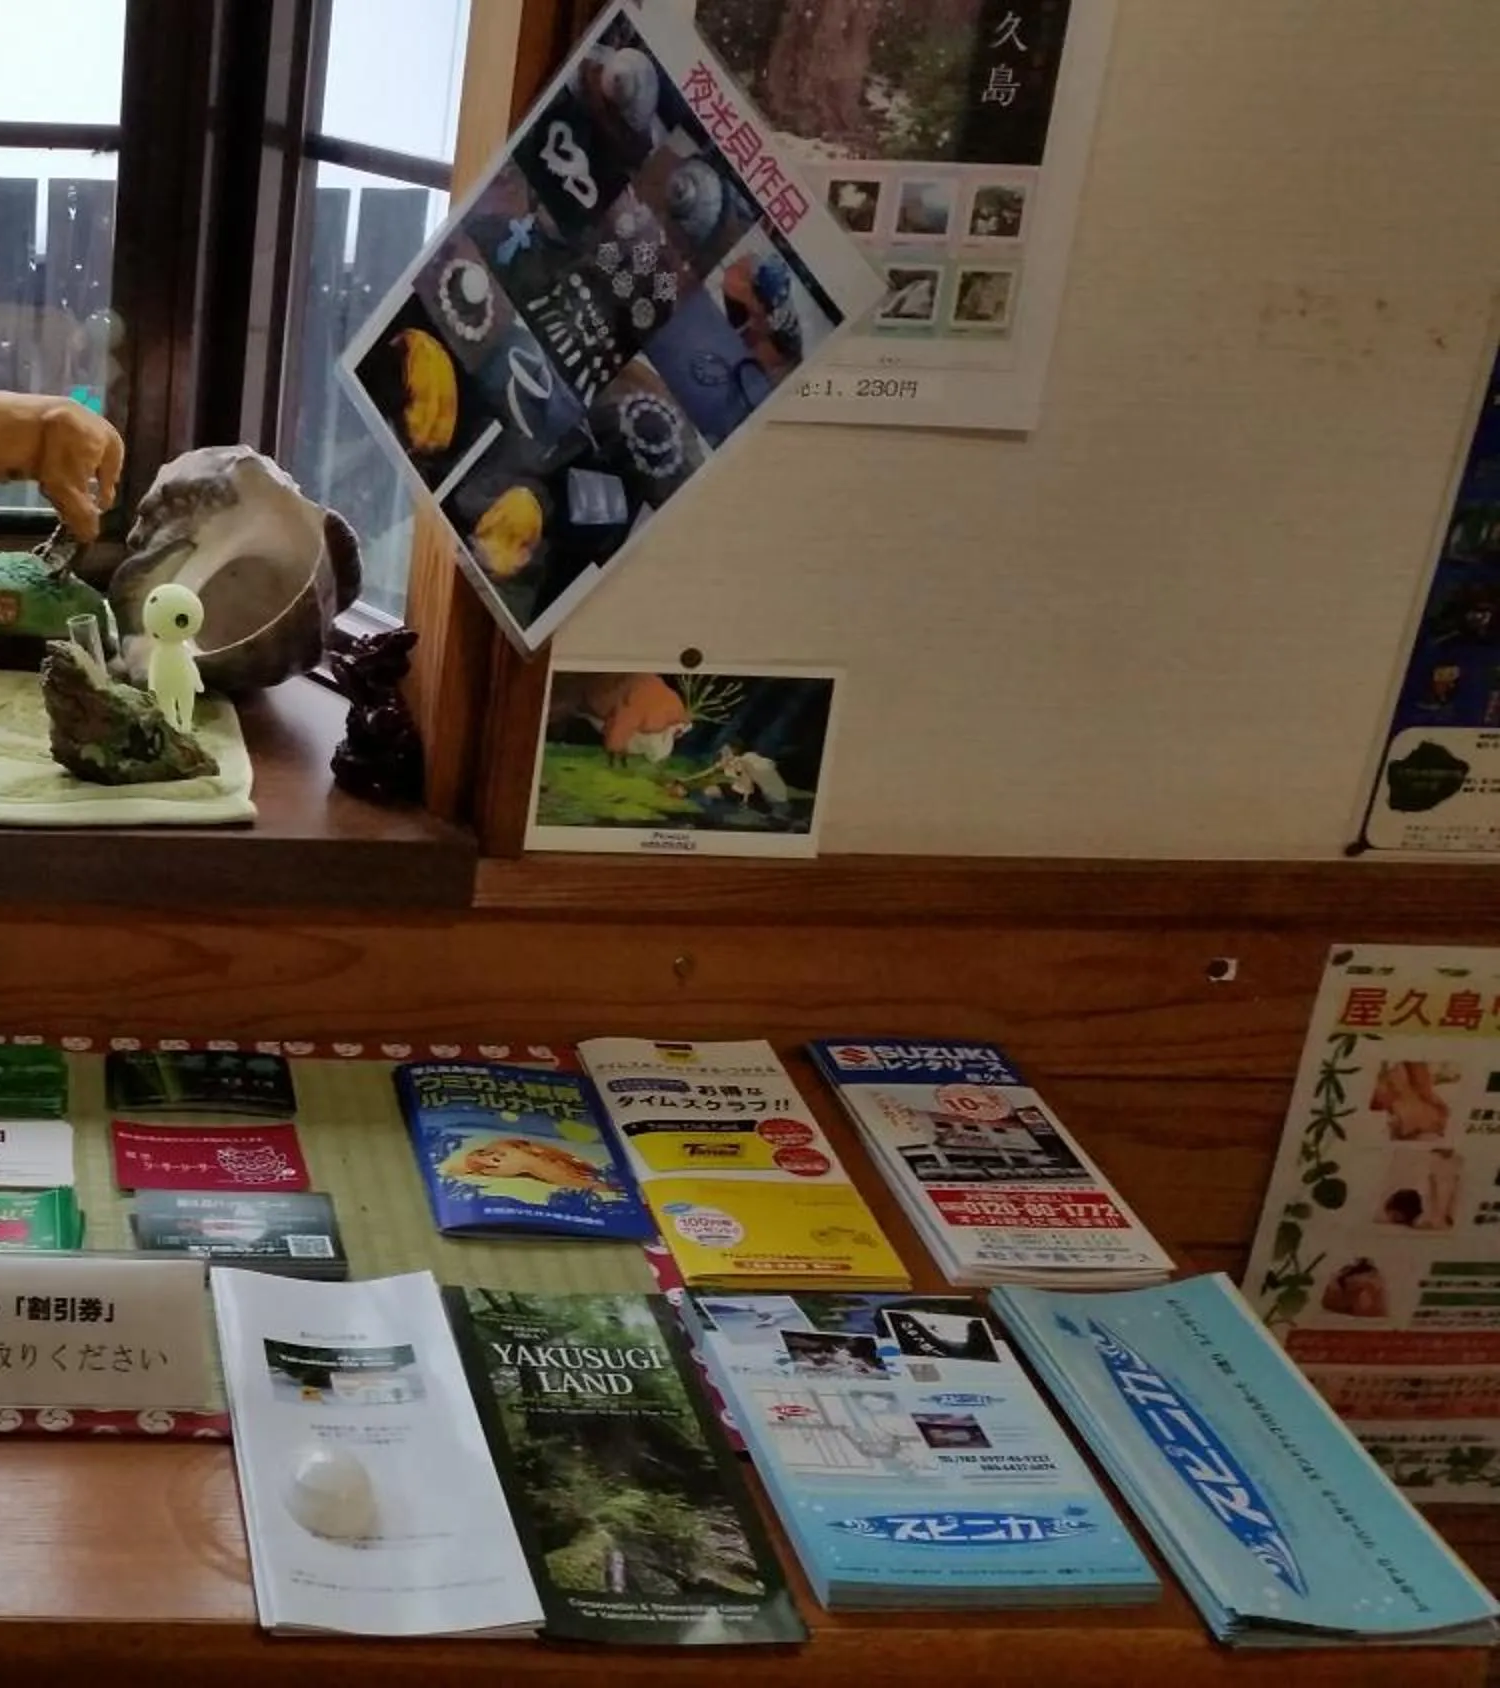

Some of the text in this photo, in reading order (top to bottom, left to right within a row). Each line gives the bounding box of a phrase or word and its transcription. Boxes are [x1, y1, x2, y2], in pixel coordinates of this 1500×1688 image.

[682, 61, 810, 234] 夜光貝作品
[1338, 986, 1500, 1031] 屋久島
[873, 1045, 1001, 1061] SUZUKI
[489, 1341, 666, 1370] YAKUSUGI
[535, 1370, 635, 1397] LAND
[885, 1514, 1047, 1541] スピニカ
